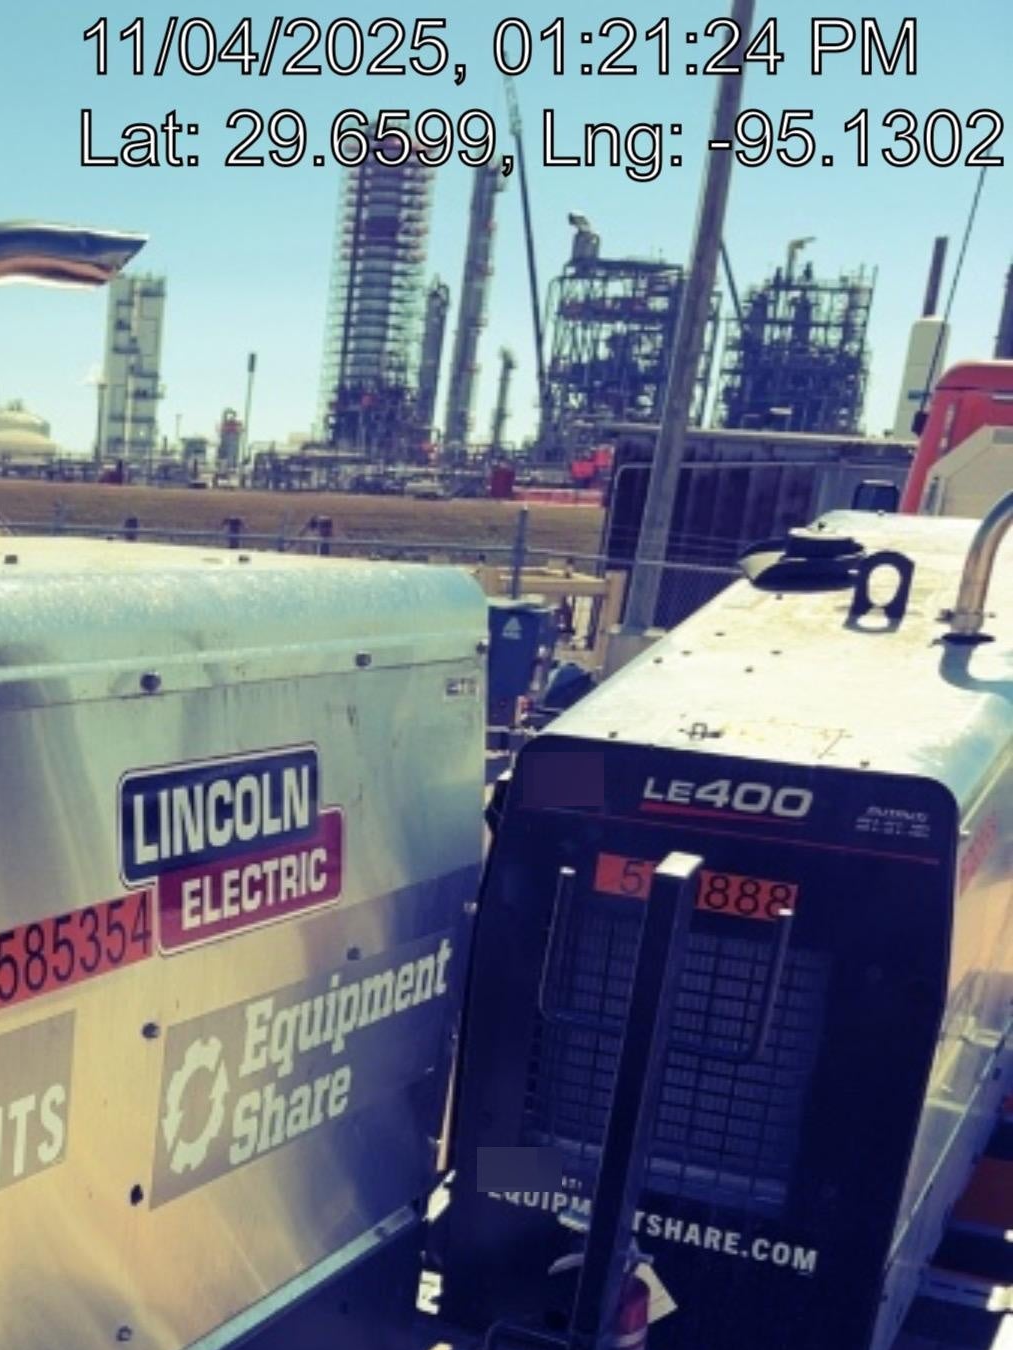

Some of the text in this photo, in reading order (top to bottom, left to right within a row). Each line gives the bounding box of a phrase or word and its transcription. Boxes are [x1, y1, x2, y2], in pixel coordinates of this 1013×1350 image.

[134, 765, 310, 864] LINCOLN
[643, 777, 814, 818] LE400
[181, 848, 327, 930] ELECTRIC
[238, 938, 454, 1076] Equipment
[228, 1066, 351, 1165] Share
